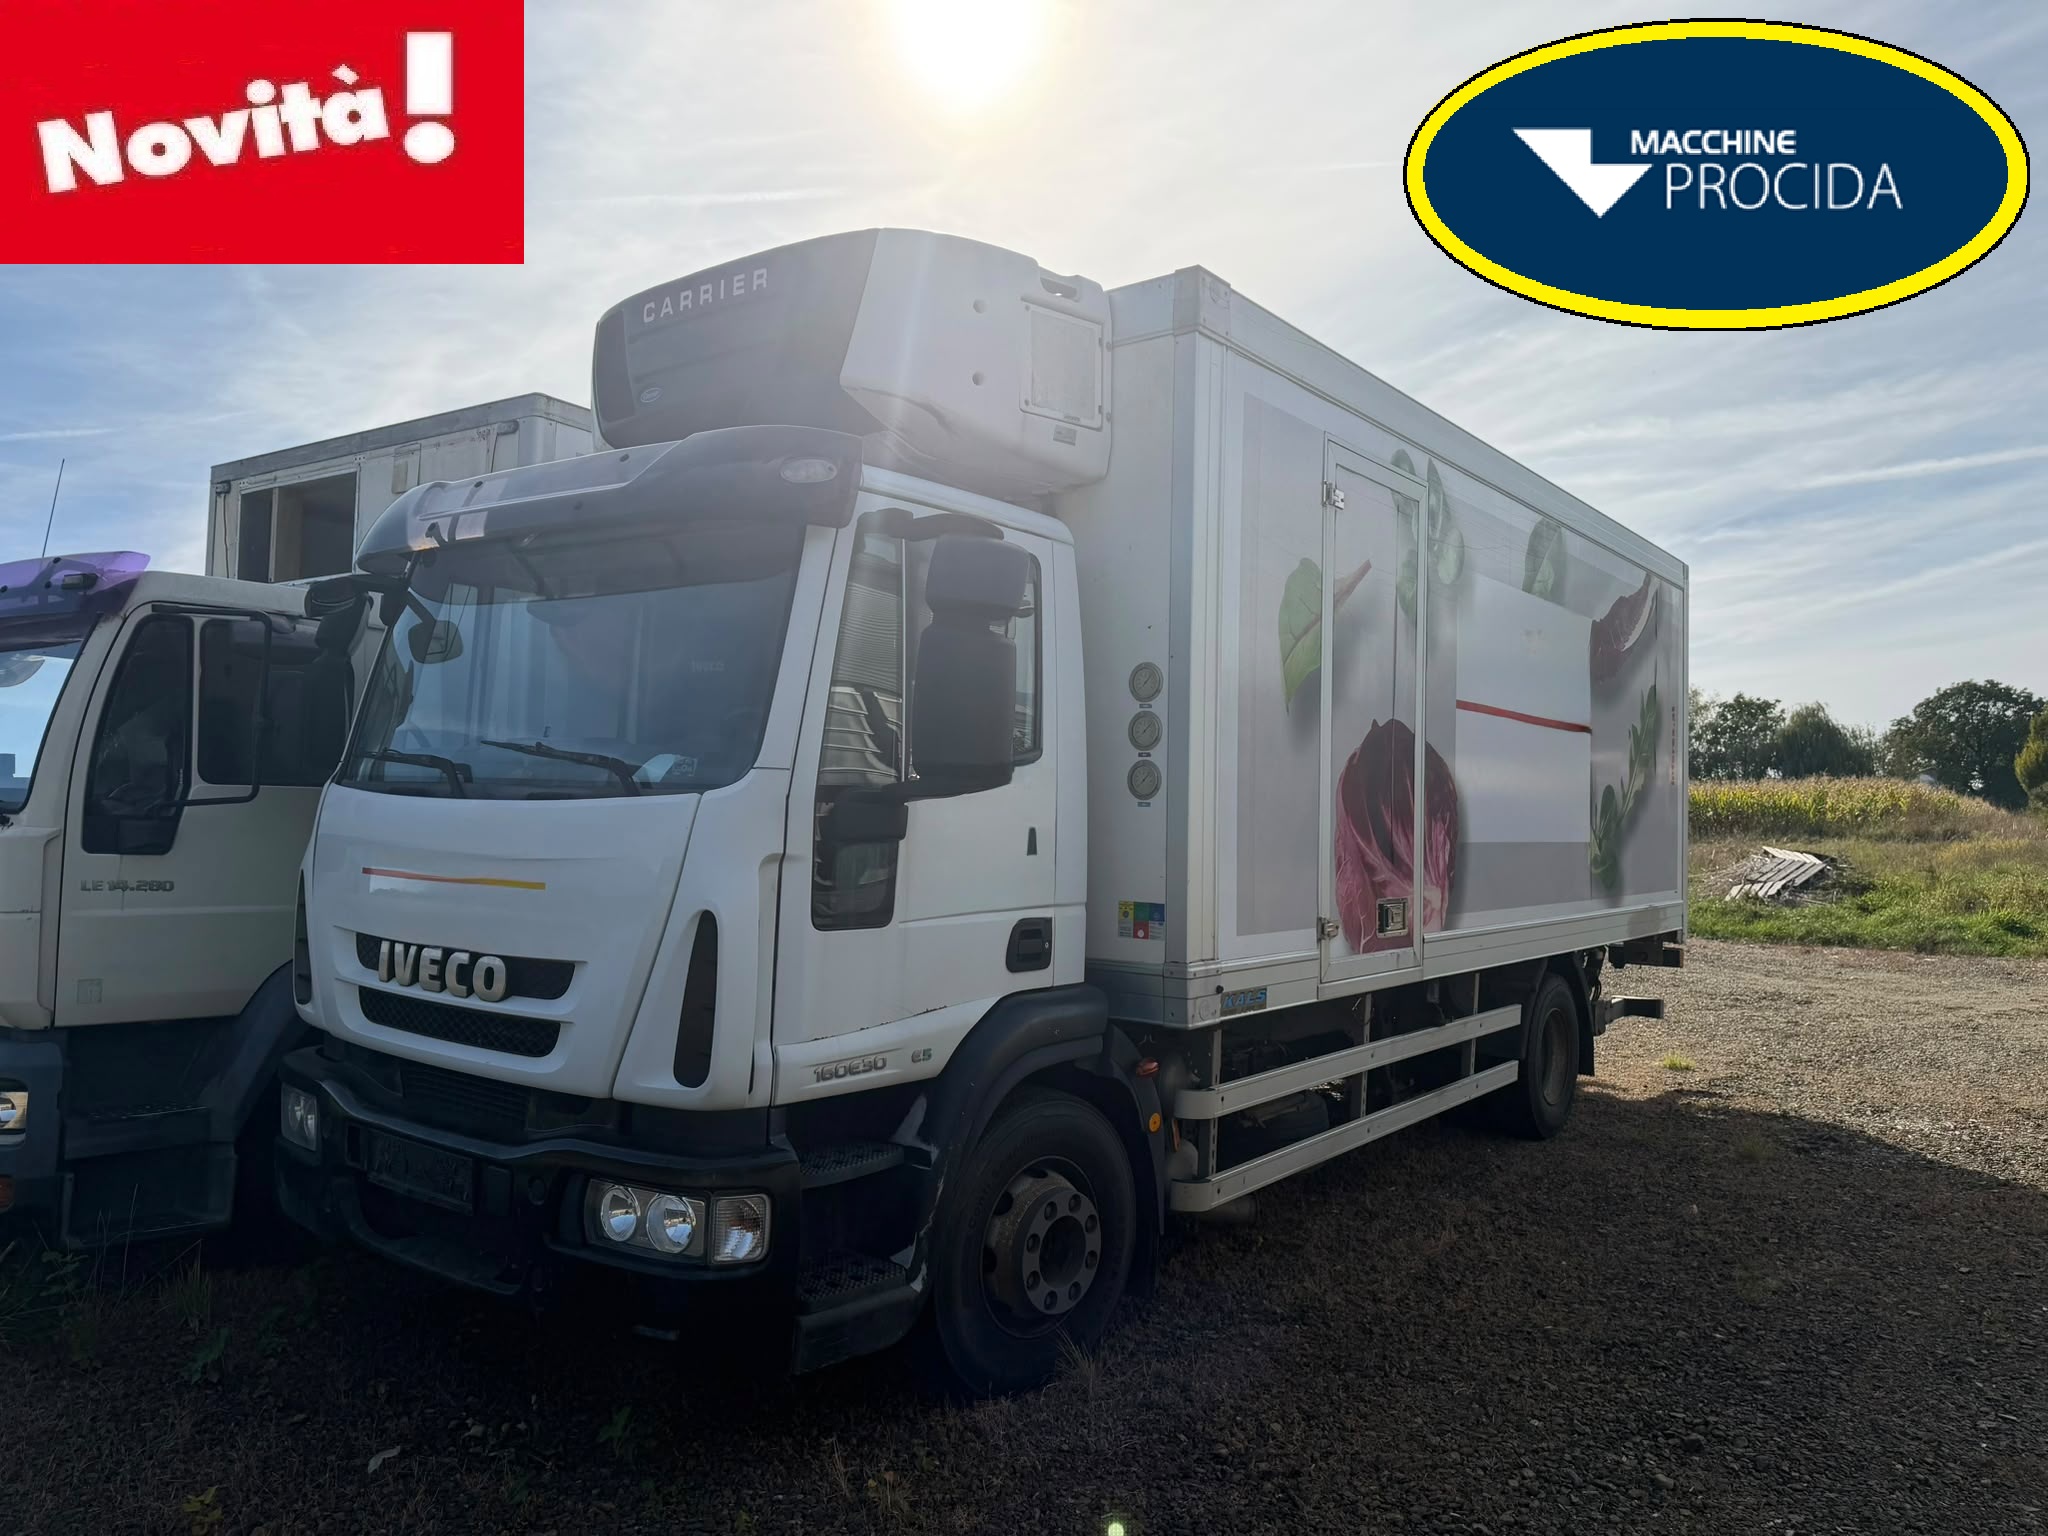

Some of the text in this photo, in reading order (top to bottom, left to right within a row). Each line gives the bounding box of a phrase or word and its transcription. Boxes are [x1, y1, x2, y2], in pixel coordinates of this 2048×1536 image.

[642, 267, 769, 324] CARRIER
[80, 880, 104, 892] LE
[377, 940, 508, 1004] IVECO
